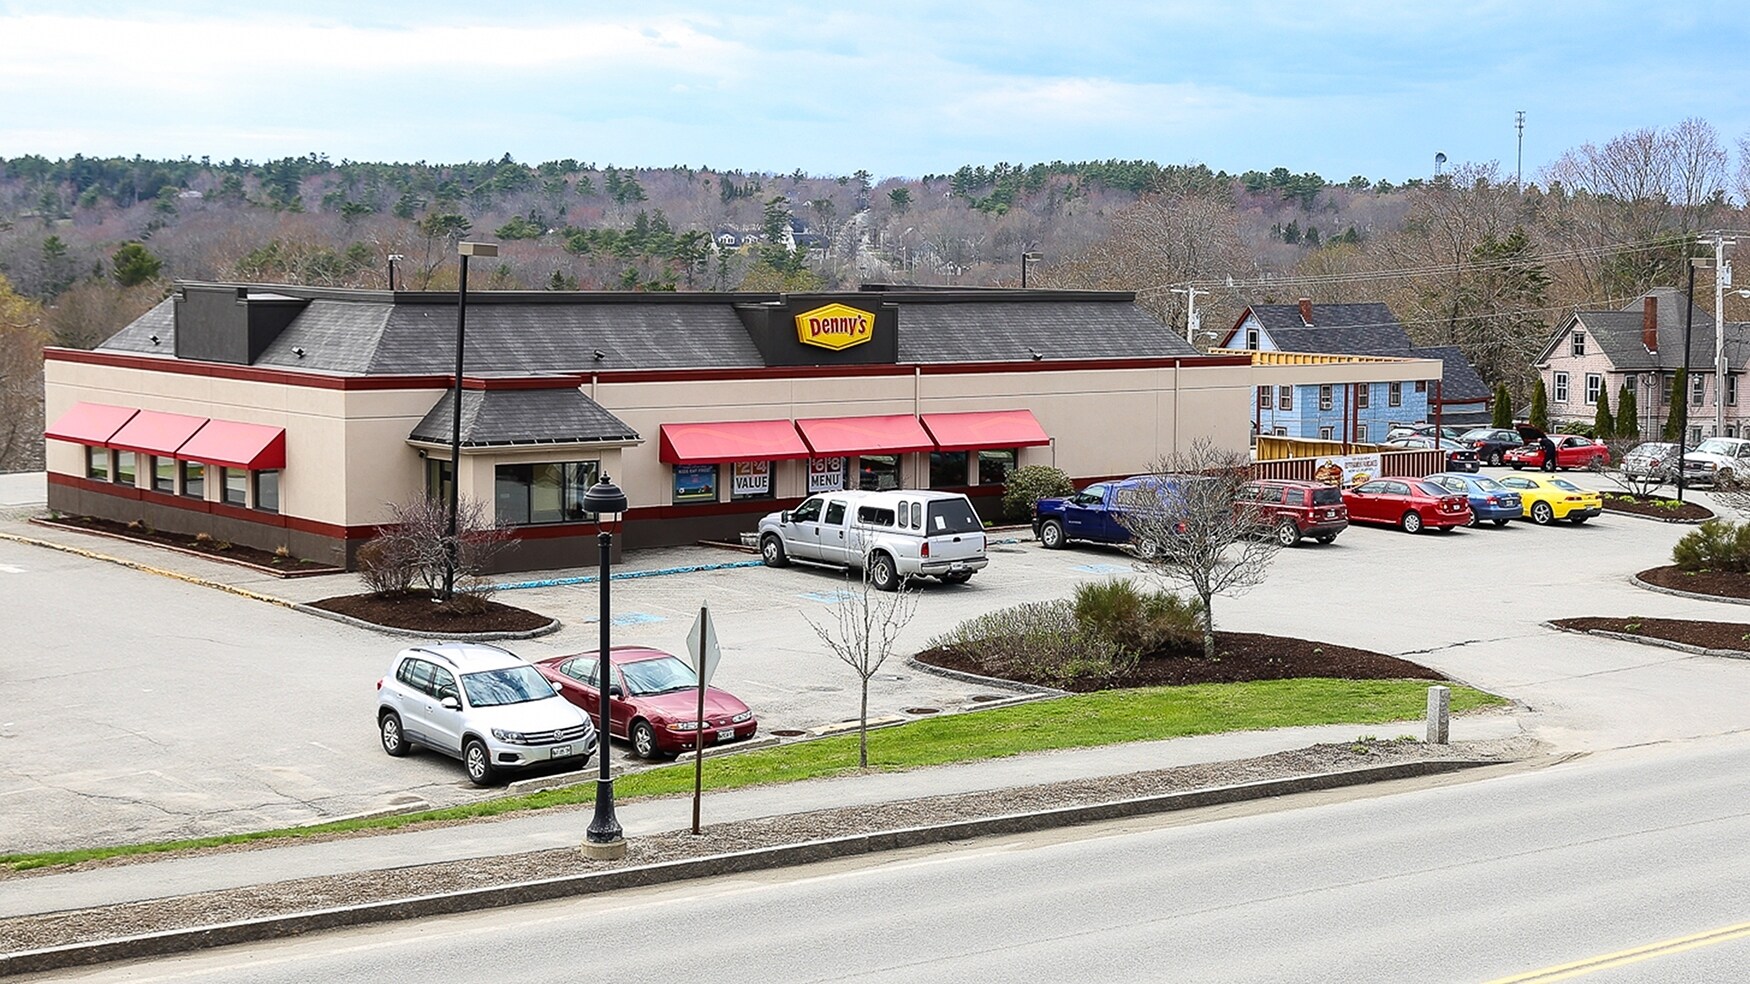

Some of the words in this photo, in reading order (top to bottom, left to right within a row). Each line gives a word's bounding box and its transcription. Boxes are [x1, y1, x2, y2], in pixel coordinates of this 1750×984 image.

[809, 314, 867, 337] Denny's
[735, 476, 768, 489] VALUE
[811, 474, 839, 487] MENU
